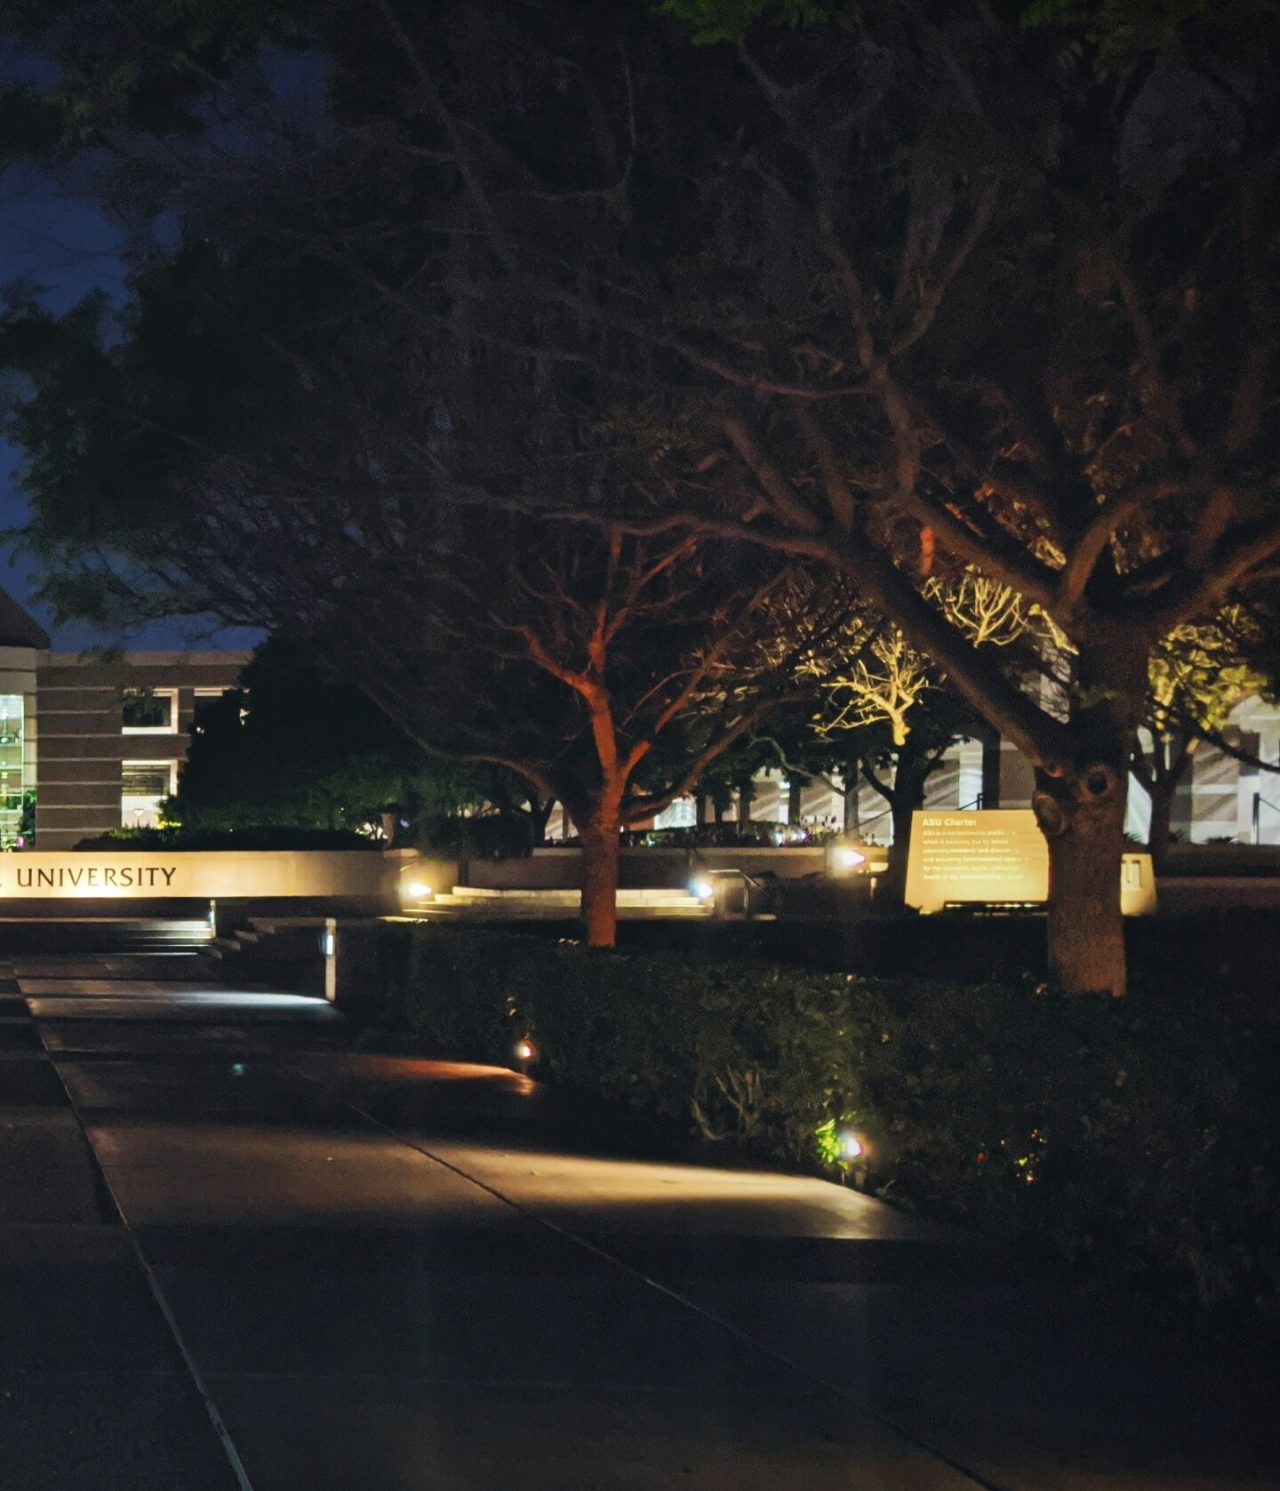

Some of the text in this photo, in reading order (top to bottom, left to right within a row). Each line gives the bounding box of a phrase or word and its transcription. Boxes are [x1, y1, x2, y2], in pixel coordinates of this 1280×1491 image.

[922, 818, 977, 827] ASU Charter
[17, 867, 177, 888] UNIVERSITY
